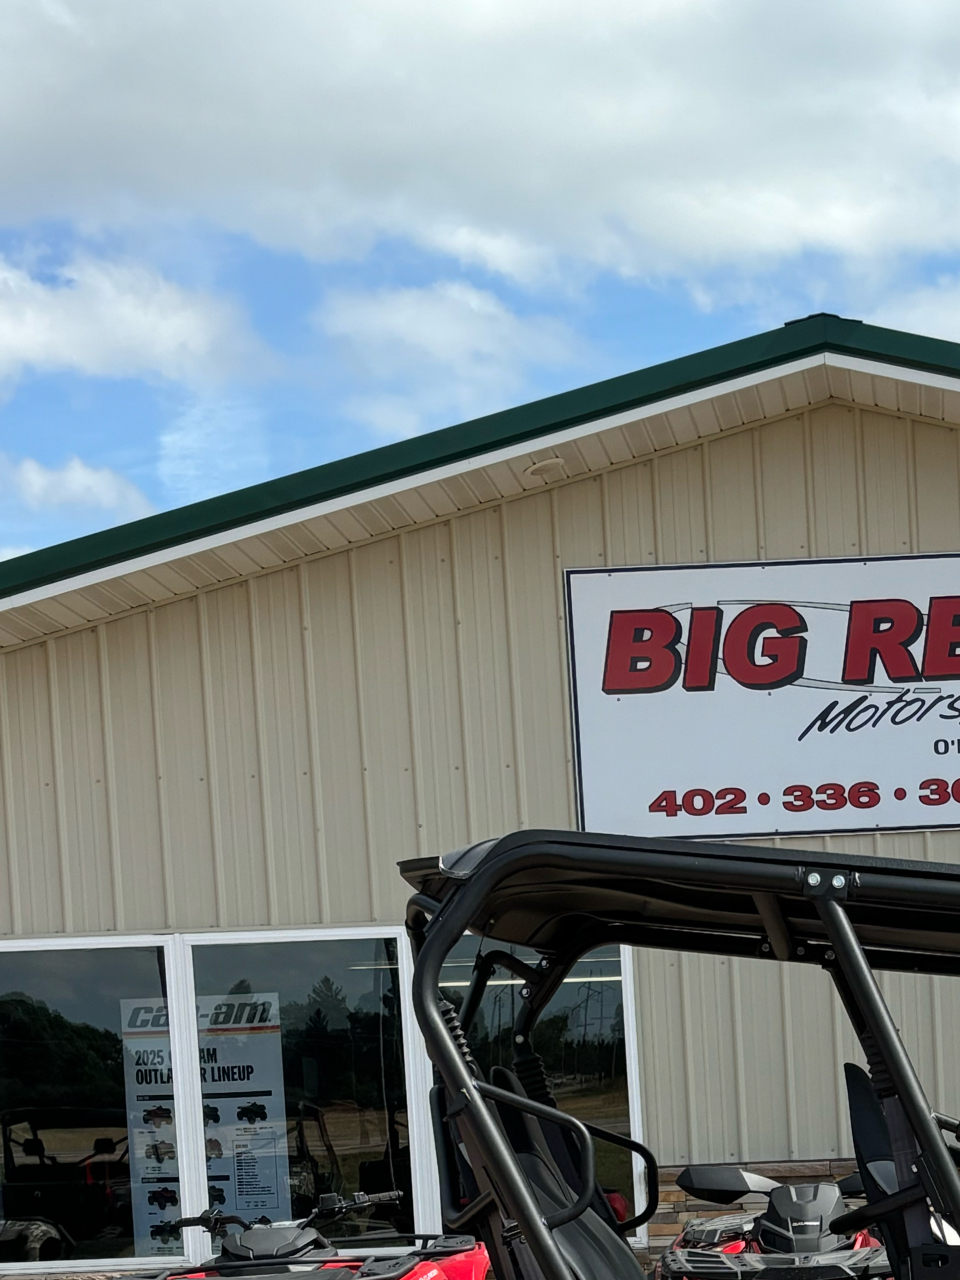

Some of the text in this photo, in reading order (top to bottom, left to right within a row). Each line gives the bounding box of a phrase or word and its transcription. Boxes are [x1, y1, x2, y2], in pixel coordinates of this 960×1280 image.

[602, 603, 808, 695] BIG
[127, 1001, 273, 1029] ca-am
[135, 1049, 165, 1067] 2025
[136, 1065, 255, 1085] OUTLAR LINEUP
